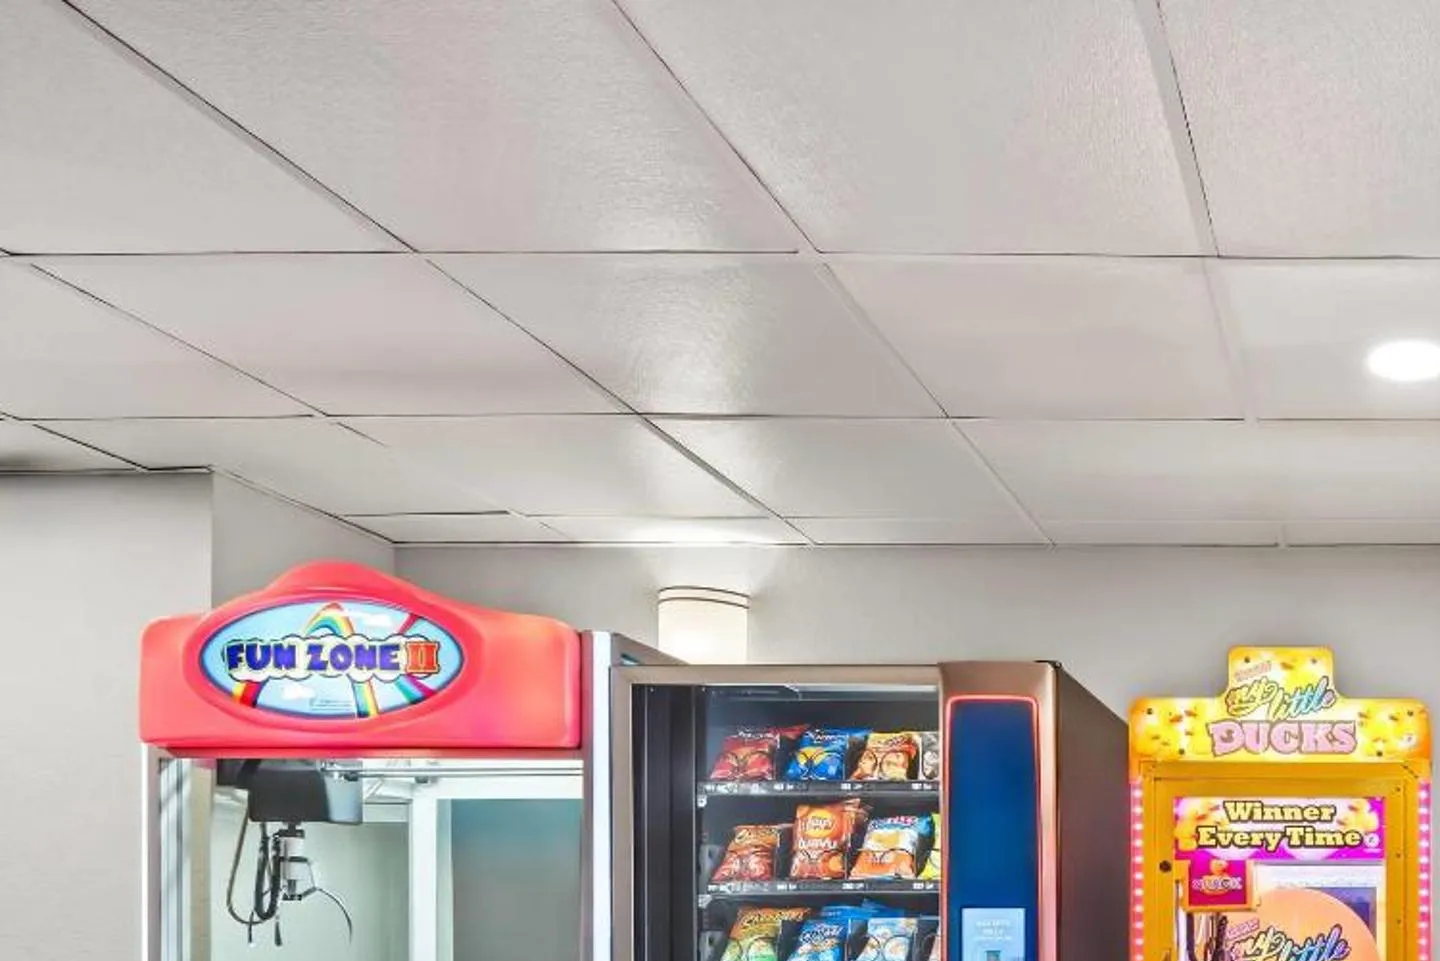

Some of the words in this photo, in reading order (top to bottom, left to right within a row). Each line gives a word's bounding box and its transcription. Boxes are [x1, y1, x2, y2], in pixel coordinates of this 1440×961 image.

[226, 643, 297, 672] FUN
[307, 643, 400, 672] ZONE
[406, 642, 440, 674] II
[1207, 720, 1358, 758] DUCKS
[1223, 801, 1336, 823] Winner
[1196, 826, 1285, 853] Every
[1286, 826, 1363, 850] Time
